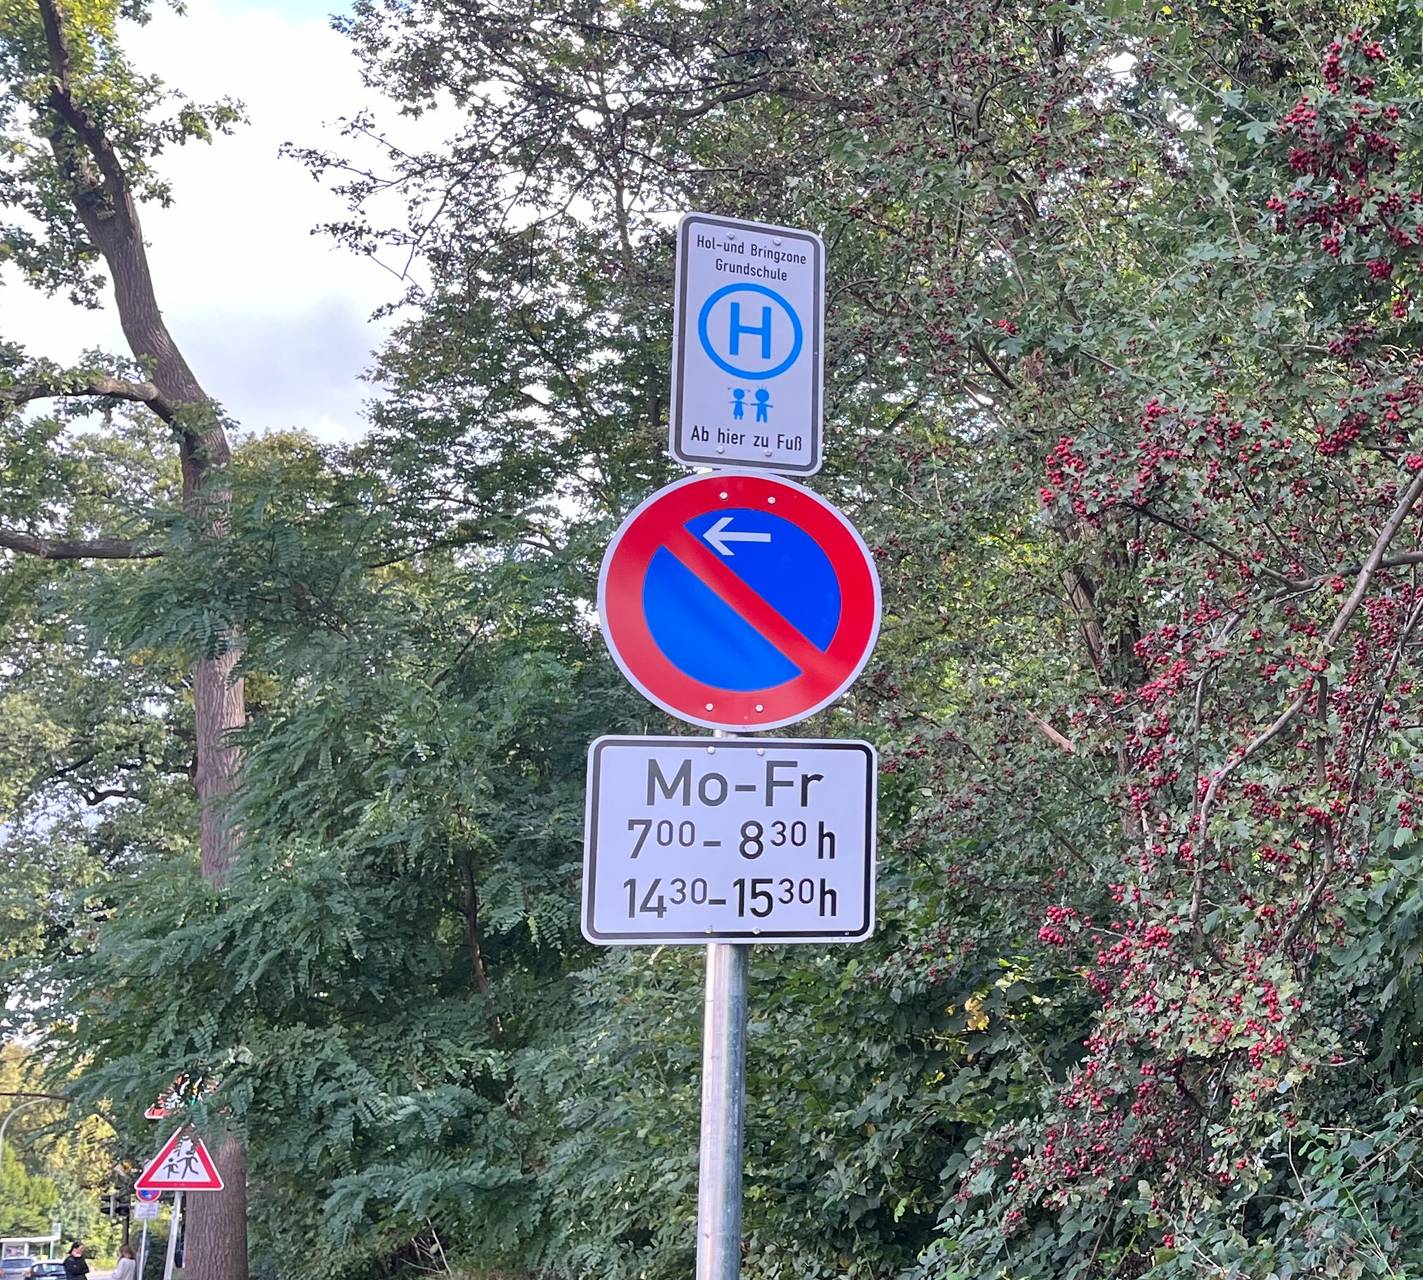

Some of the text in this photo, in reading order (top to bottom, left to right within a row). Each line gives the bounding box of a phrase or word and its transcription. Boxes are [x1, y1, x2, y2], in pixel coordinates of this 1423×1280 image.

[750, 246, 807, 265] Bringzone
[715, 258, 788, 281] Grundschule
[729, 302, 772, 359] H
[691, 425, 802, 451] Ab hier zu Fuß
[646, 758, 825, 808] Mo-Fr
